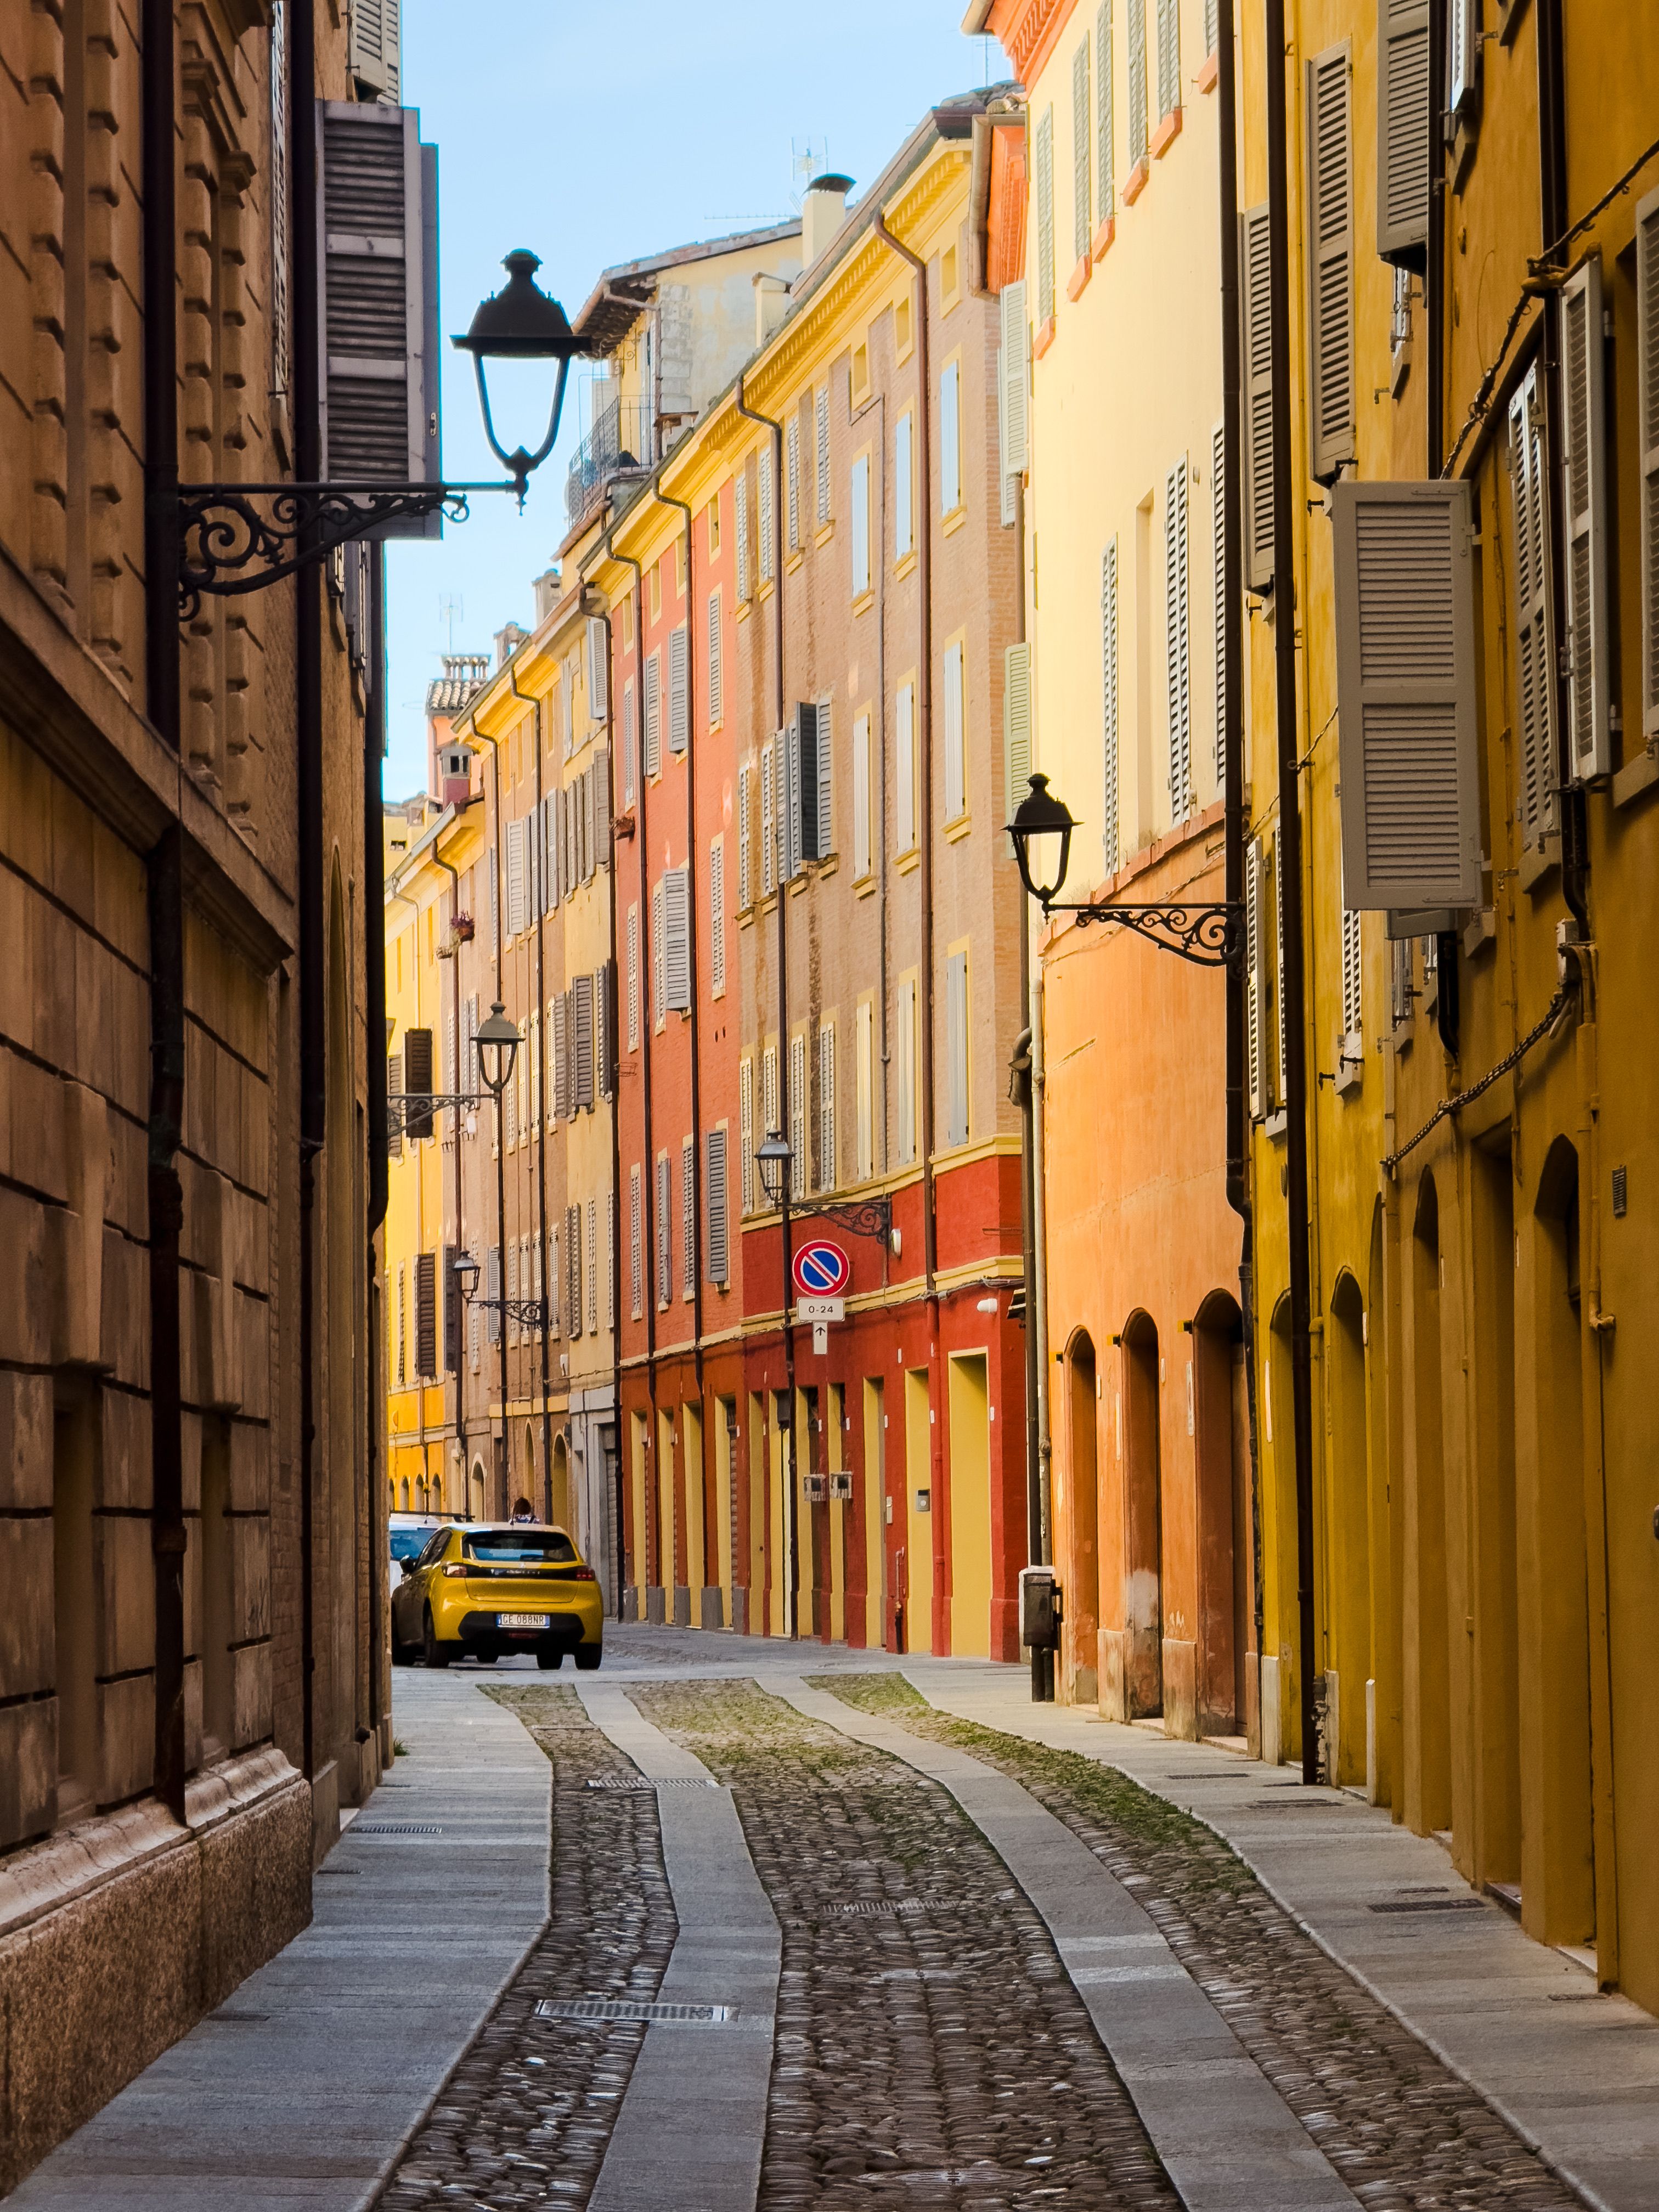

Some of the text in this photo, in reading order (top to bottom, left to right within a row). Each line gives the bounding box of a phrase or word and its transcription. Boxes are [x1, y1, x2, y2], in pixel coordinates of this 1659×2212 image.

[808, 1305, 833, 1313] 0-24
[503, 1615, 544, 1624] GE 088NR
